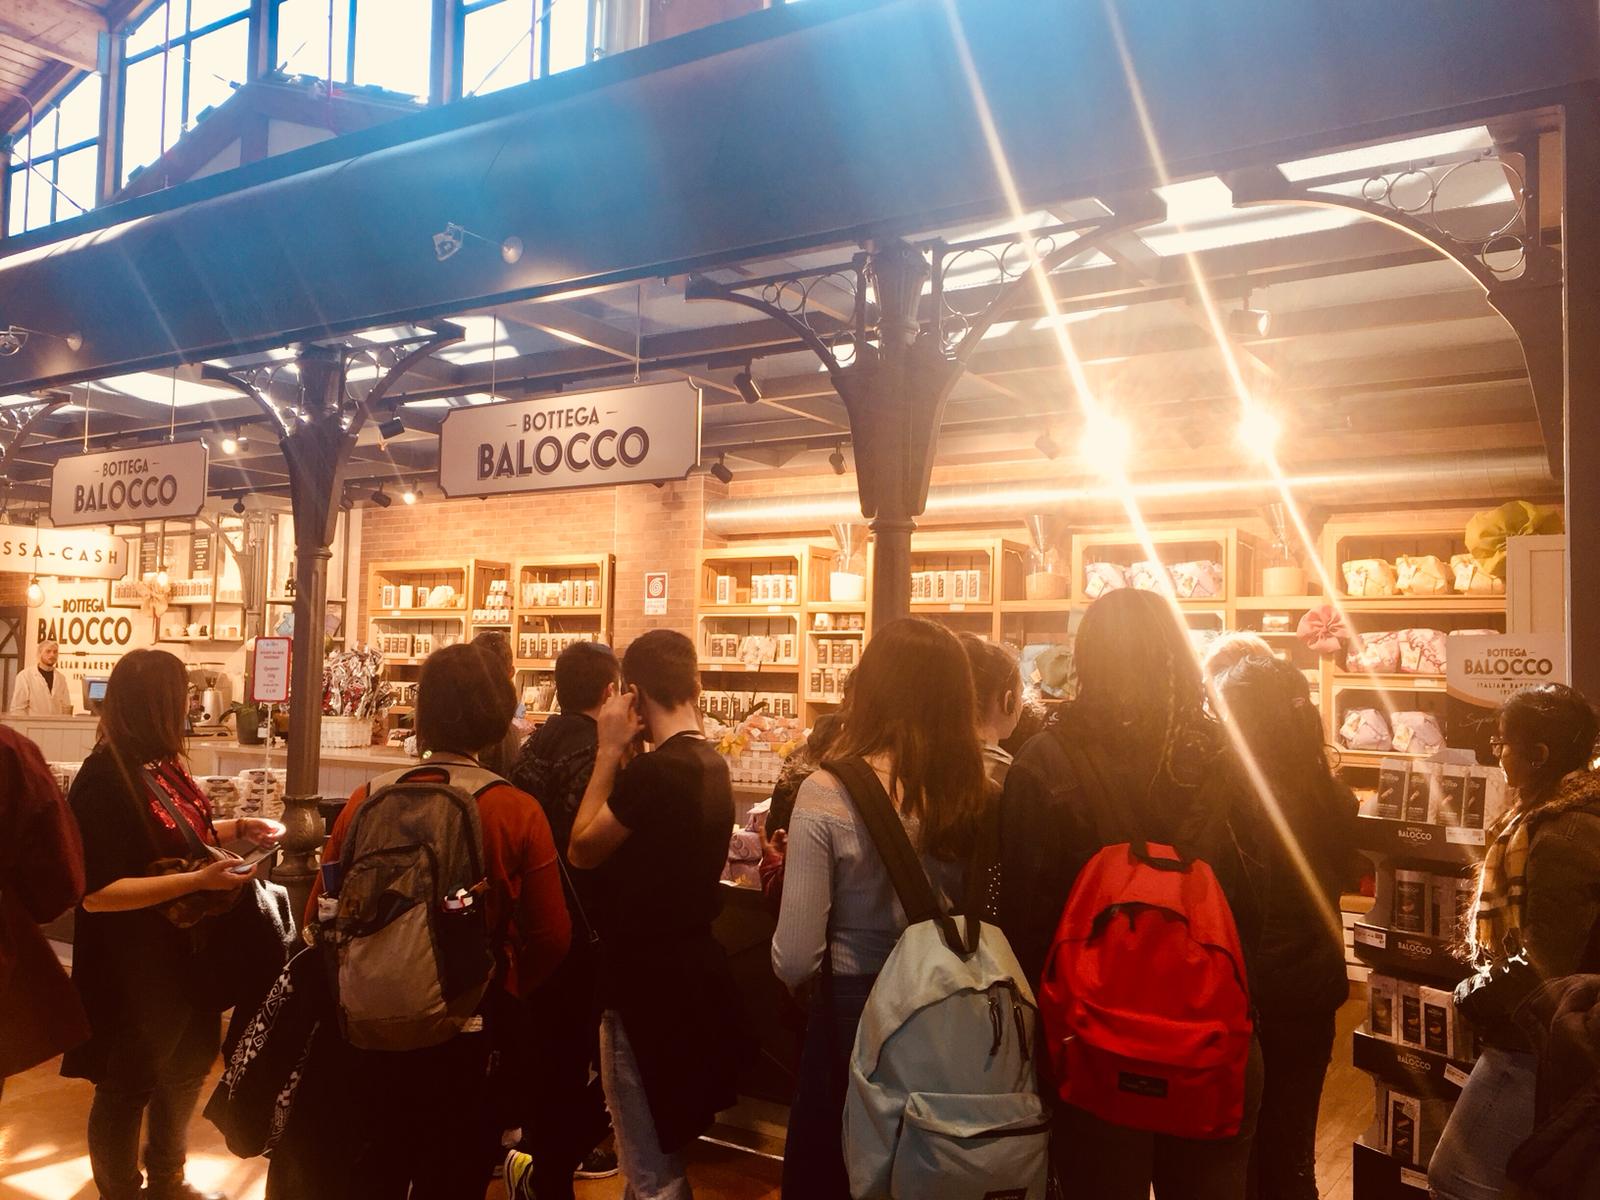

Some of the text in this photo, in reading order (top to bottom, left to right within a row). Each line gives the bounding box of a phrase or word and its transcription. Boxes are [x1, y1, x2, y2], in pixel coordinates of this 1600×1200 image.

[522, 406, 600, 432] BOTTEGA
[477, 426, 650, 480] BALOCCO
[102, 458, 149, 476] BOTTEGA
[74, 474, 177, 513] BALOCCO
[62, 598, 105, 613] BOTTEGA
[37, 617, 132, 645] BALOCCO
[1486, 648, 1528, 657] BOTTEGA
[1464, 658, 1553, 675] BALOCCO
